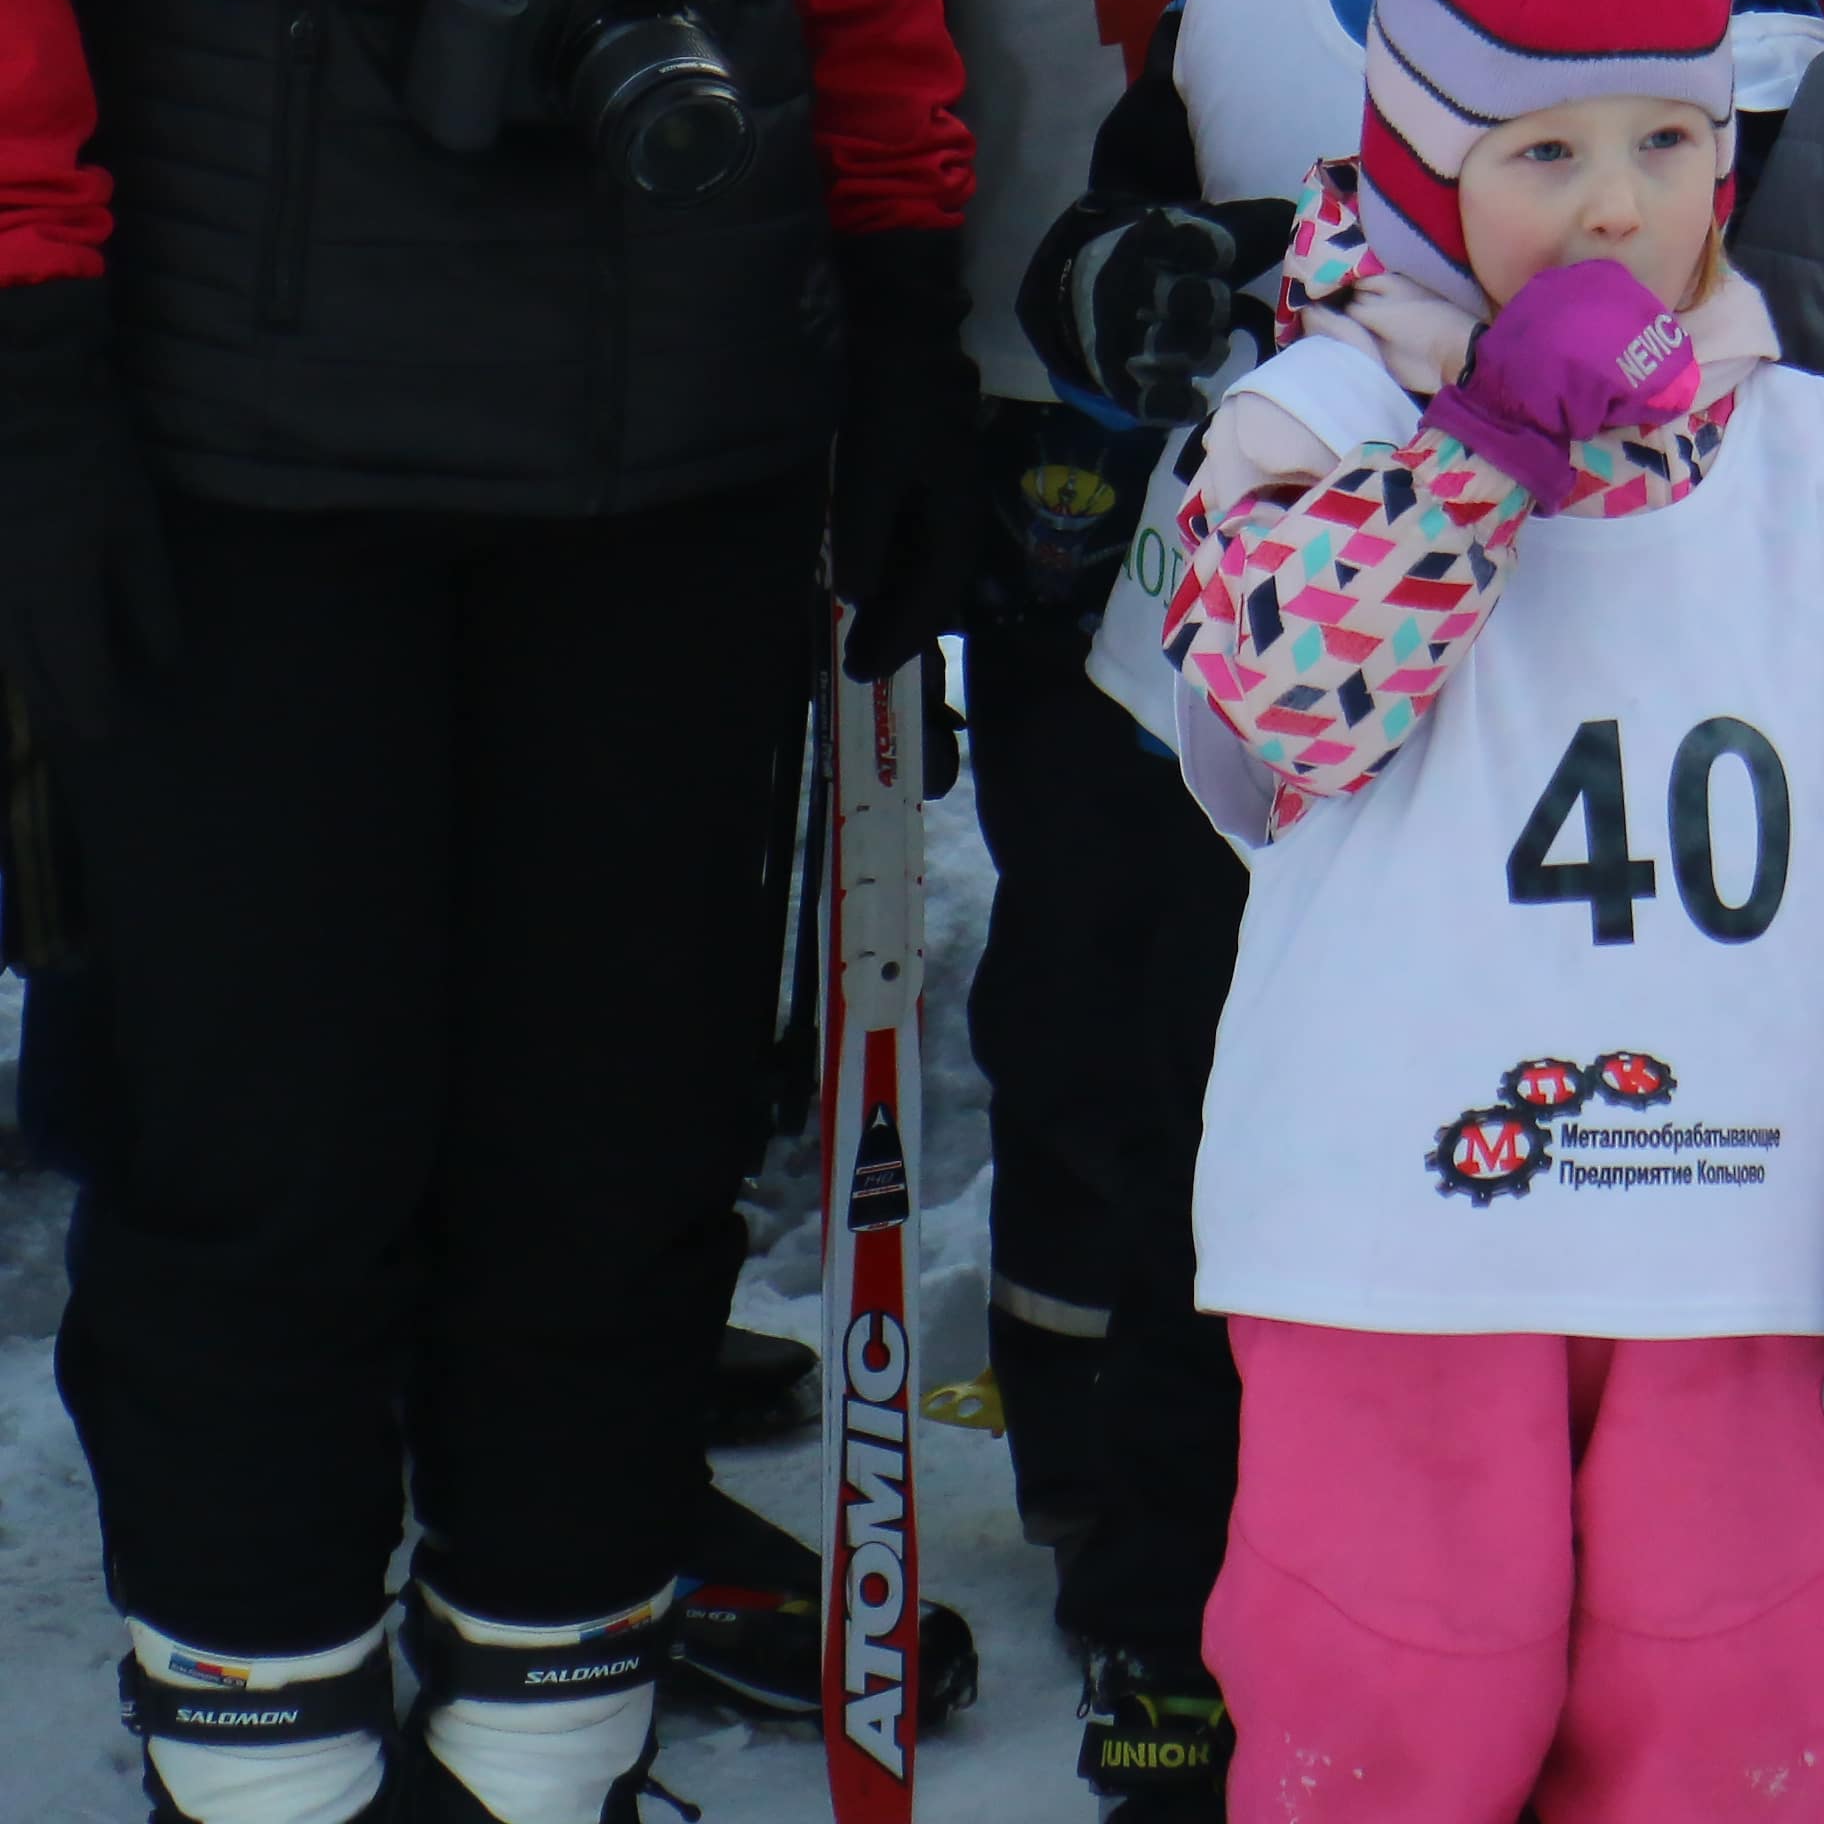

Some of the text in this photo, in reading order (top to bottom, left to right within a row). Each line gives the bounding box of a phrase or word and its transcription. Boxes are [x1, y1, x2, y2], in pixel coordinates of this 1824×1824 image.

[1615, 314, 1688, 389] NEVIC
[1507, 716, 1792, 947] 40
[1561, 1123, 1781, 1153] Металлообрабатывающее
[1559, 1159, 1765, 1191] Предприятие Кольцово
[845, 1309, 911, 1780] ATOMIC
[525, 1658, 640, 1685] SALOMON
[175, 1708, 299, 1727] SALOMON
